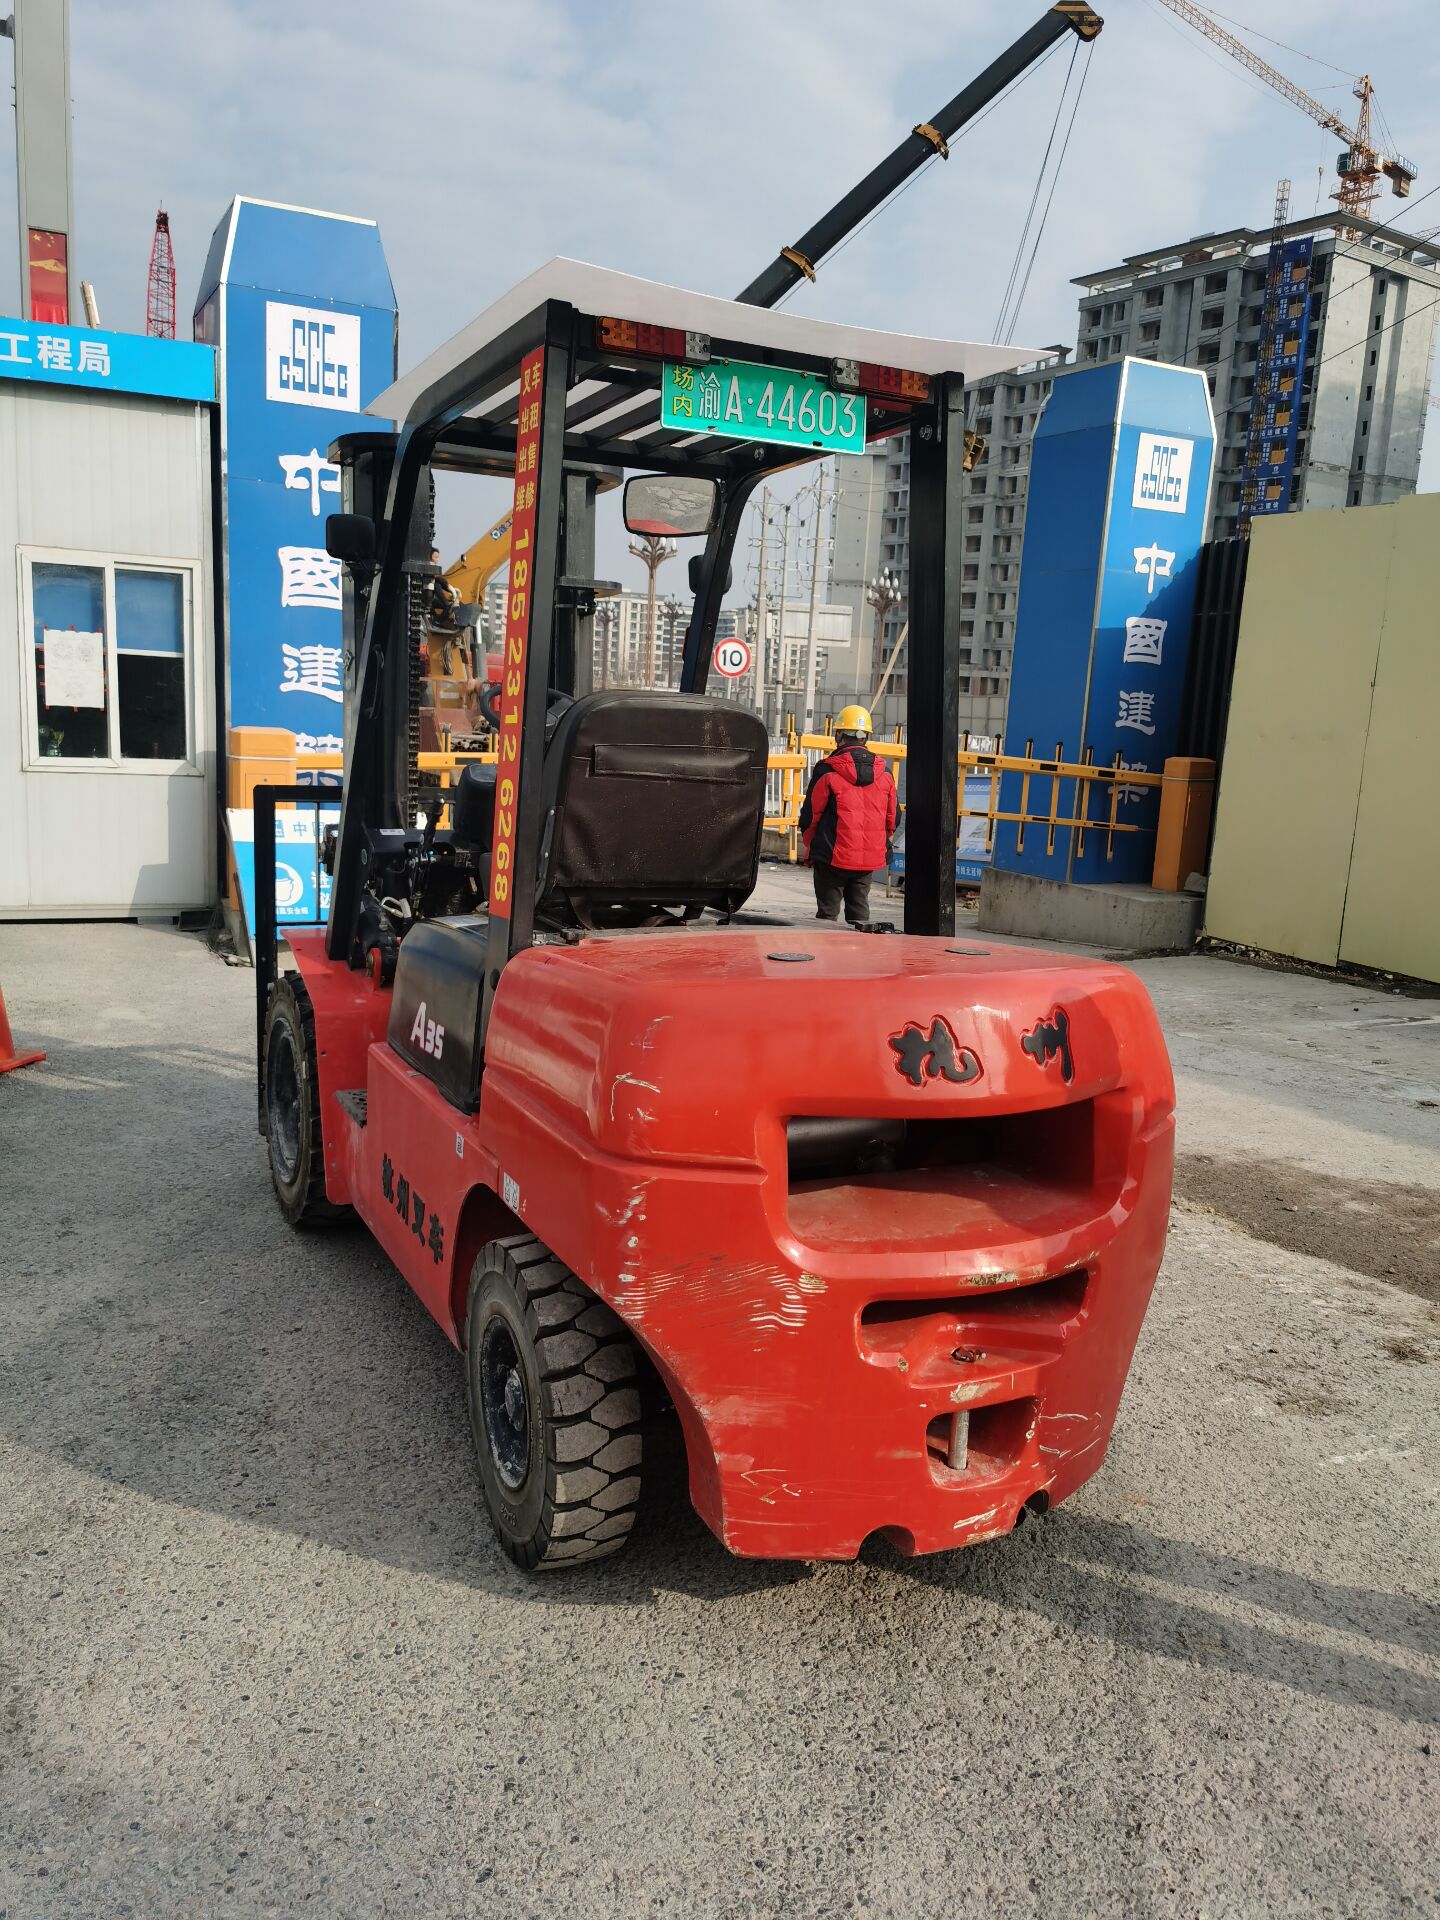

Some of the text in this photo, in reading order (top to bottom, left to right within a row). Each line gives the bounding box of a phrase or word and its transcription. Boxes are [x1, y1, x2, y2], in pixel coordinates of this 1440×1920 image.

[0, 331, 111, 378] 工程局
[523, 361, 541, 395] 叉车
[520, 402, 539, 435] 出租
[699, 371, 857, 438] 渝A·44603
[518, 442, 537, 474] 出售
[515, 480, 535, 512] 维修
[721, 649, 743, 667] 10
[494, 528, 530, 902] 185 2312 6268
[410, 1001, 445, 1060] A35
[382, 1153, 444, 1265] 杭州叉车
